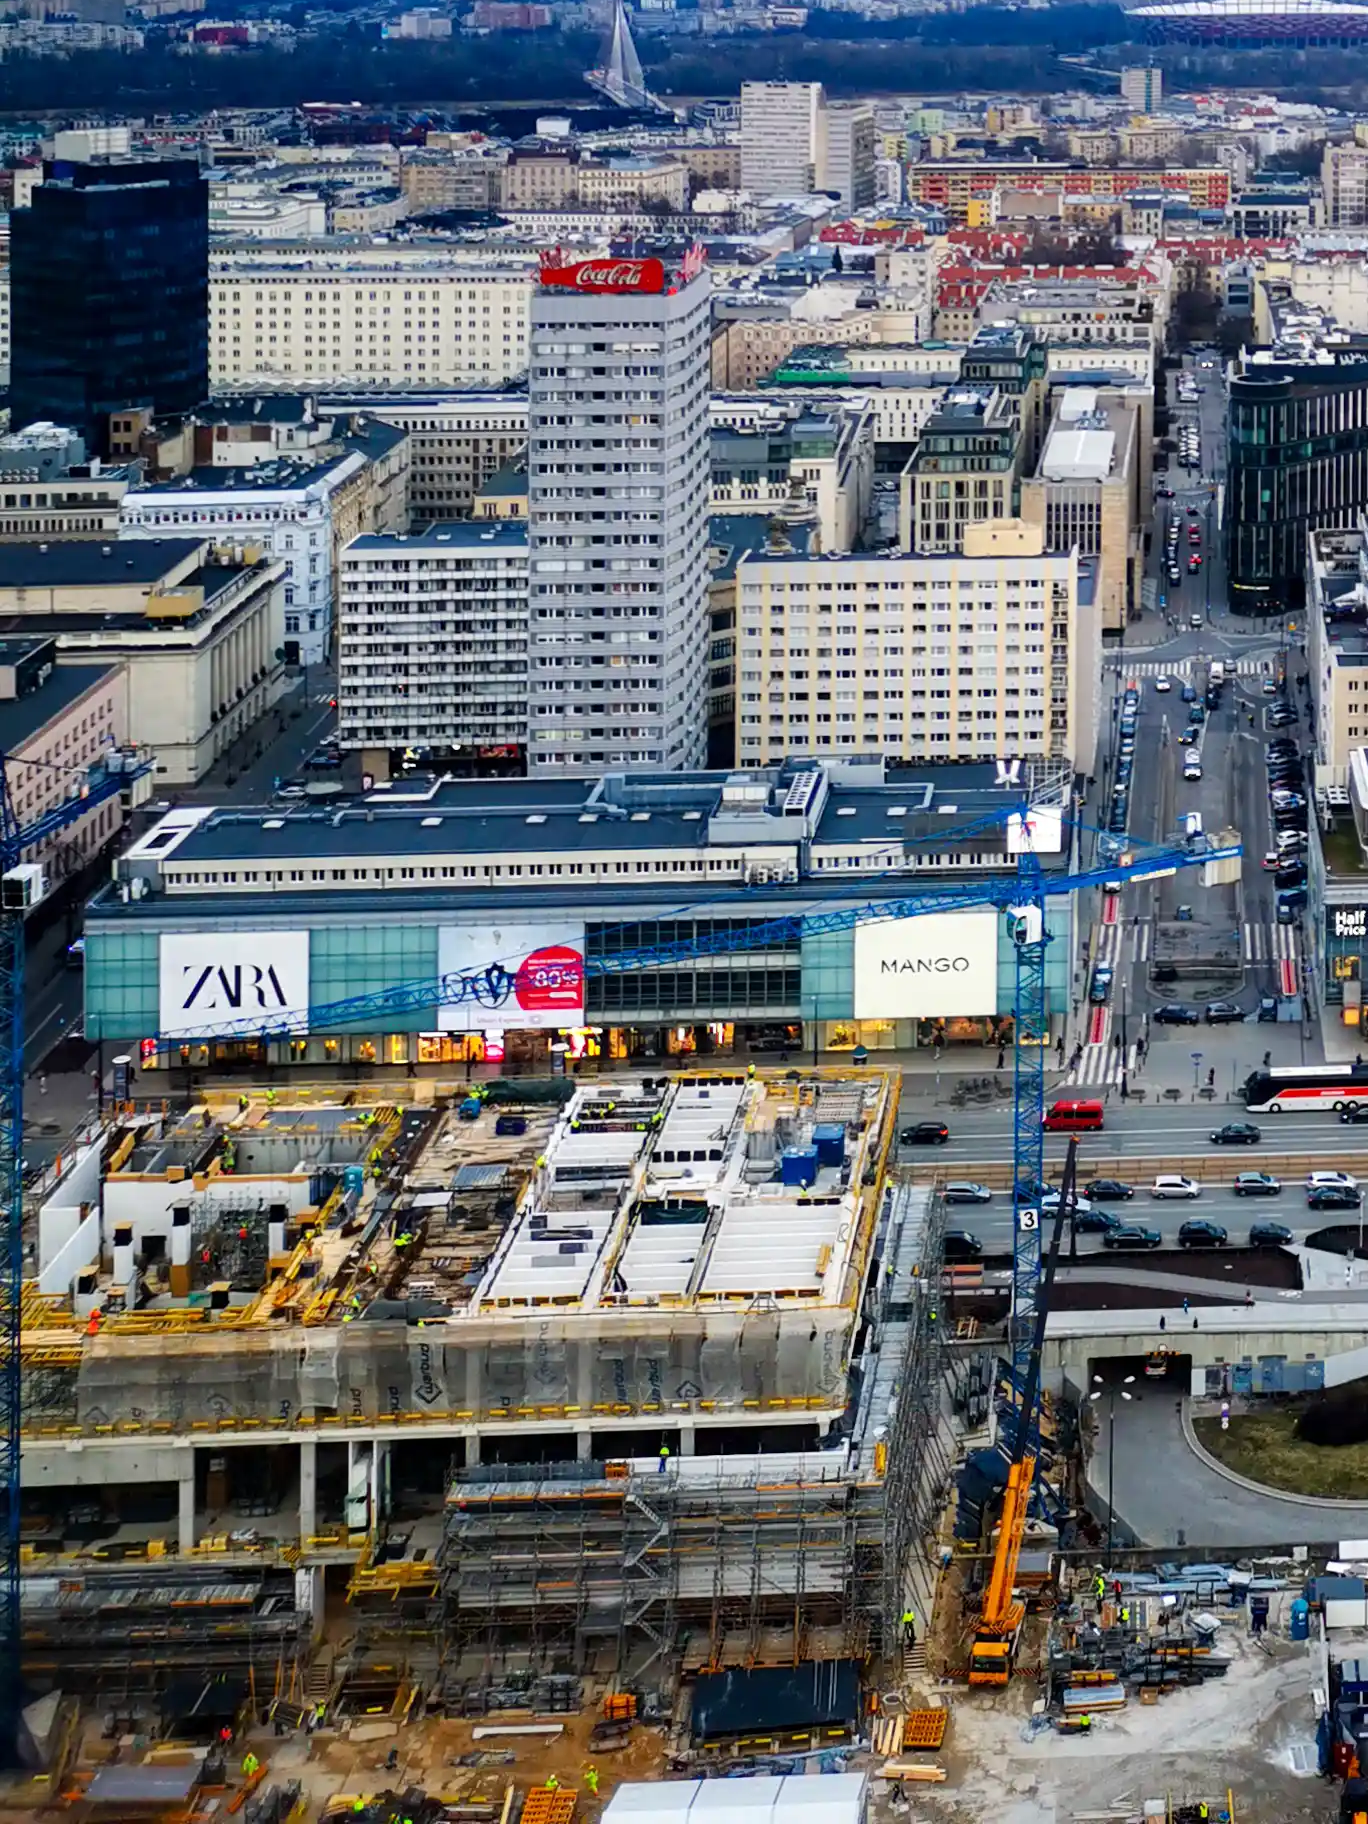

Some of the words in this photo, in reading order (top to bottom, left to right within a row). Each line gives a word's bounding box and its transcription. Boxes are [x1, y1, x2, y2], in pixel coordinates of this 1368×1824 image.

[1335, 910, 1366, 925] Half
[1335, 925, 1367, 937] Price
[881, 957, 969, 973] MANGO
[182, 964, 290, 1009] ZARA
[1023, 1211, 1035, 1227] 3
